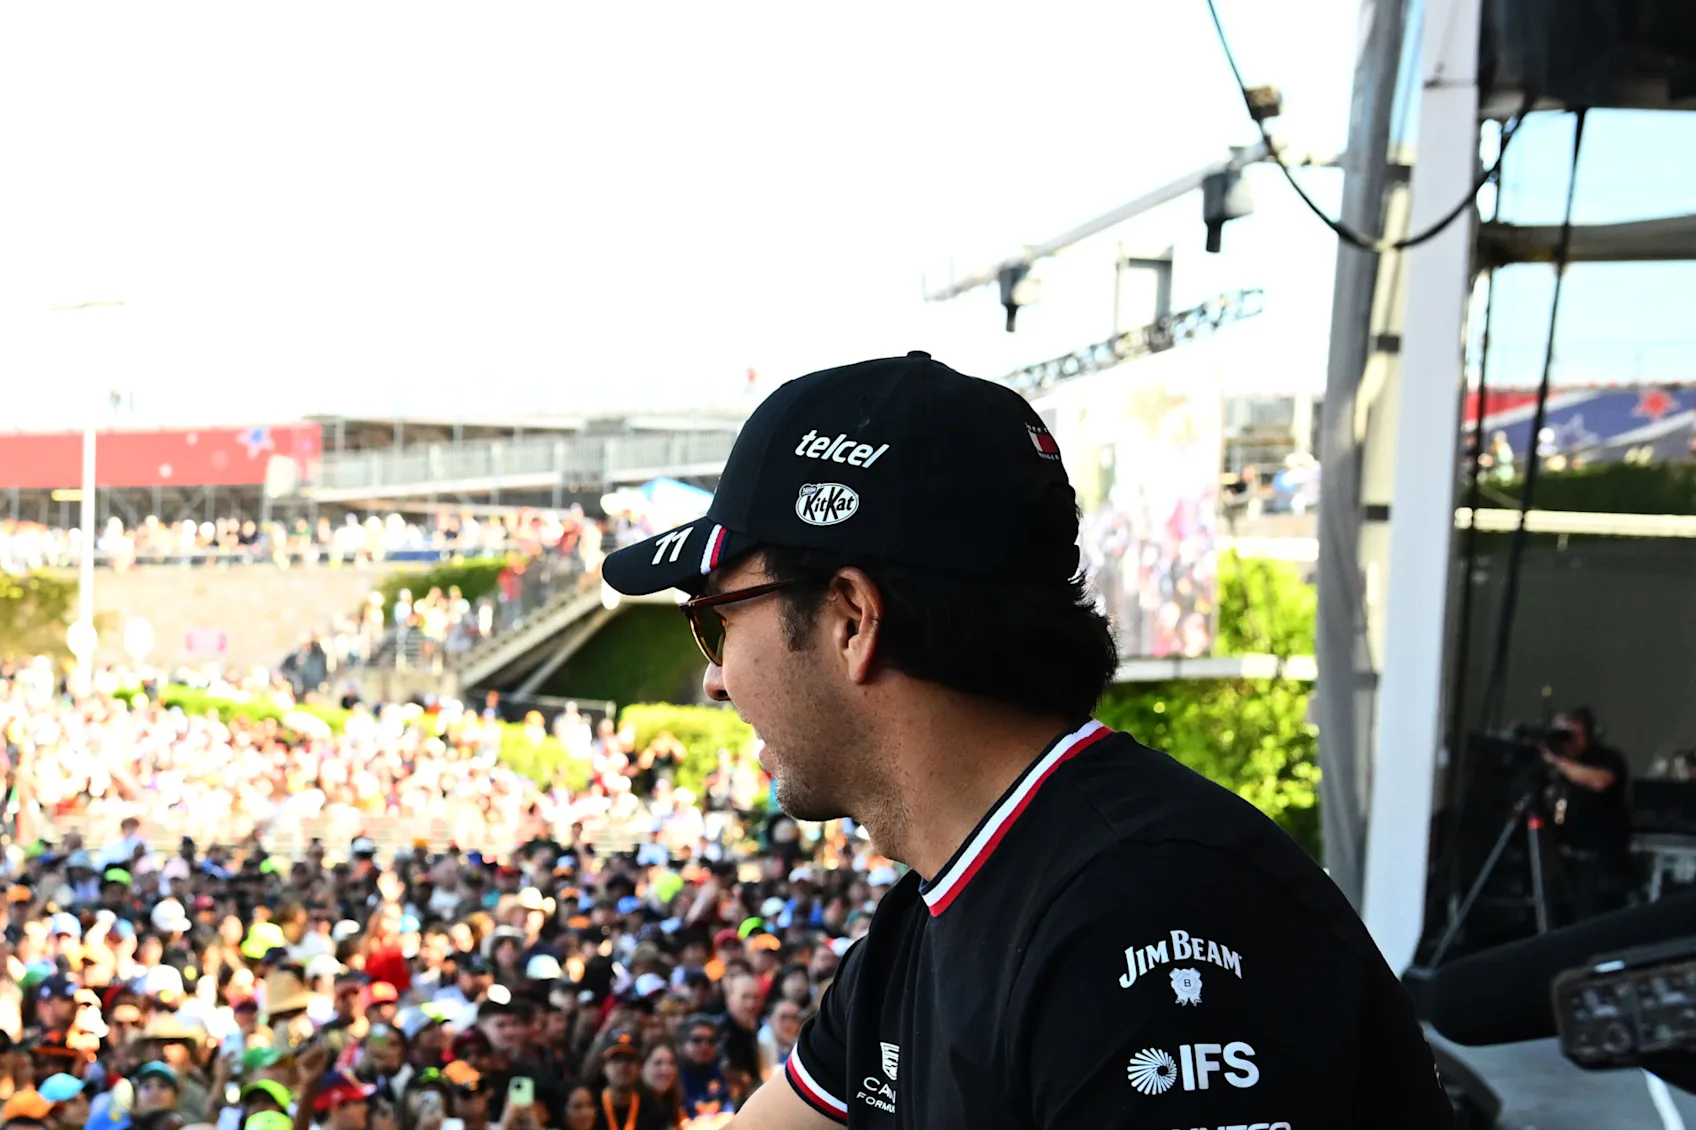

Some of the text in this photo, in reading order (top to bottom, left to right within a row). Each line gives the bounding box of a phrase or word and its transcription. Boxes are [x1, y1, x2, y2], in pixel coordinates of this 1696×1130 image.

[794, 429, 890, 469] telcel
[651, 526, 695, 565] 11
[1118, 929, 1243, 989] JIM BEAM
[1179, 1041, 1260, 1091] IFS
